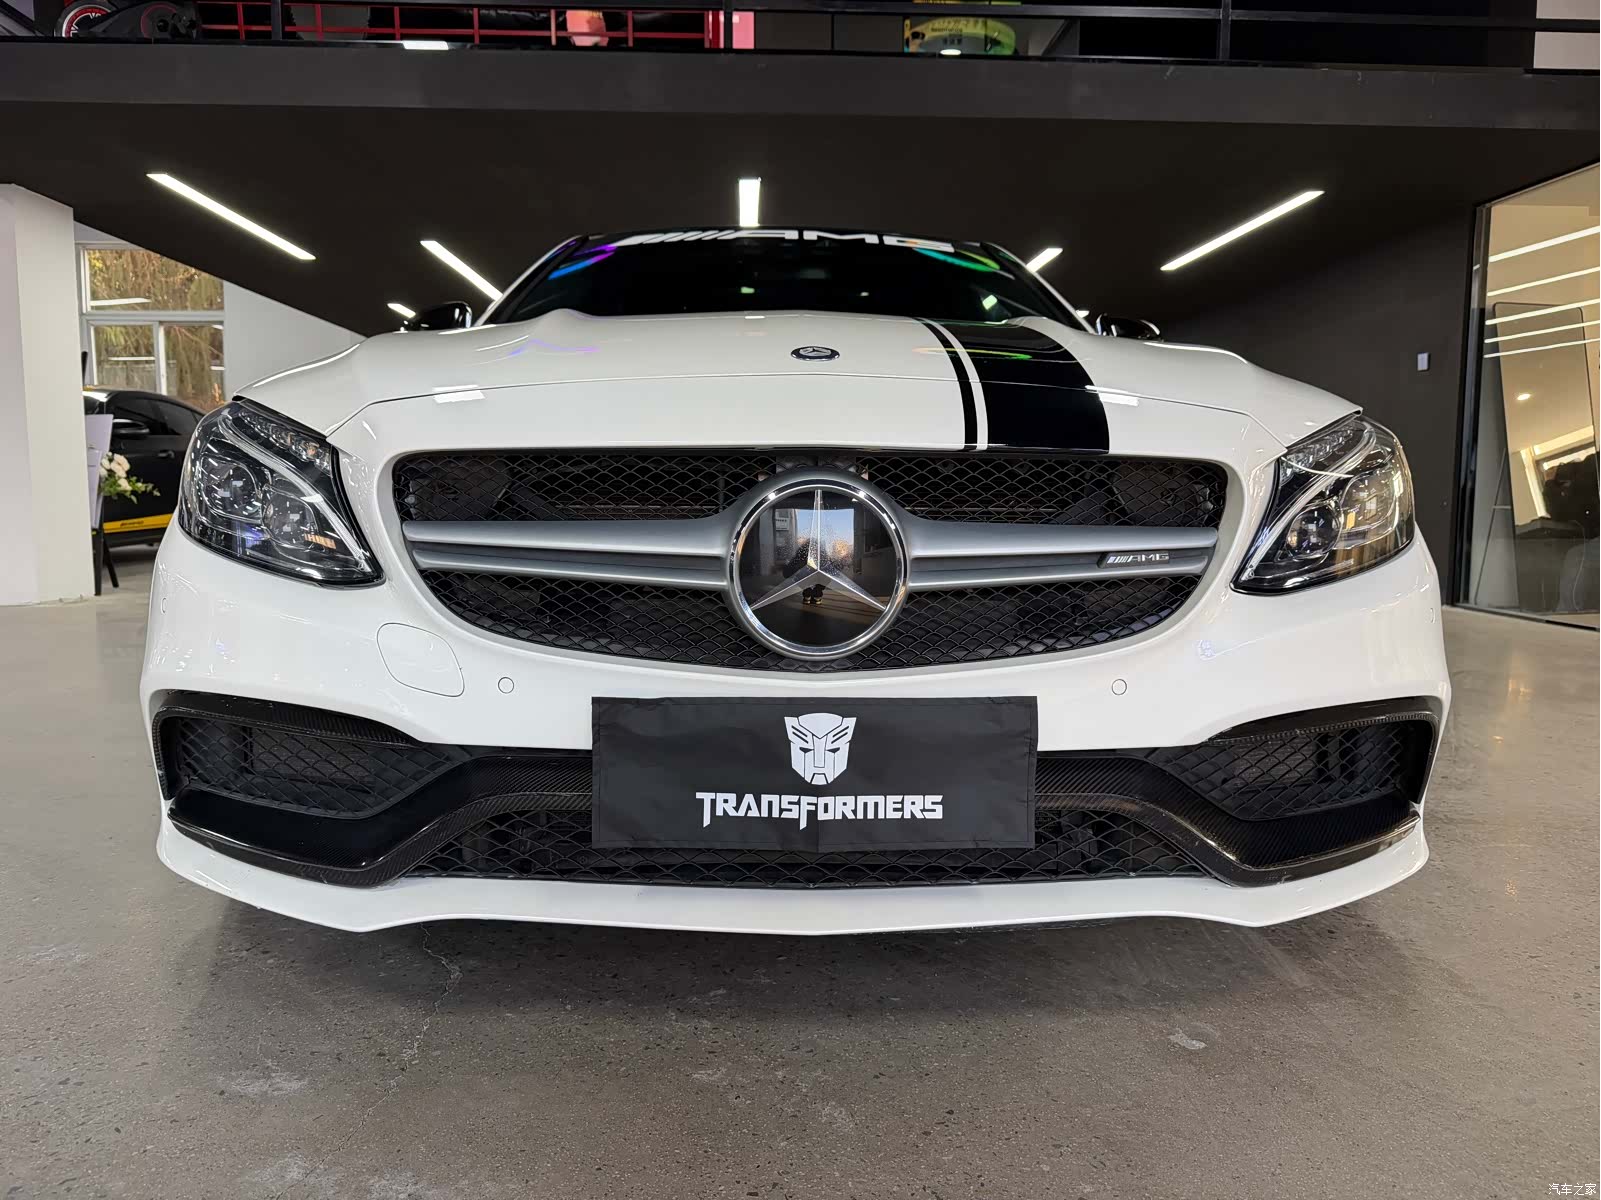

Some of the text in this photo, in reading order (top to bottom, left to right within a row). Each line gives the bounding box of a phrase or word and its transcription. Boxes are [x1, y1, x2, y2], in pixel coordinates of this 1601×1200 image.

[717, 229, 955, 253] AMG
[1127, 553, 1169, 563] AMG
[695, 792, 943, 830] TRANSFORMERS
